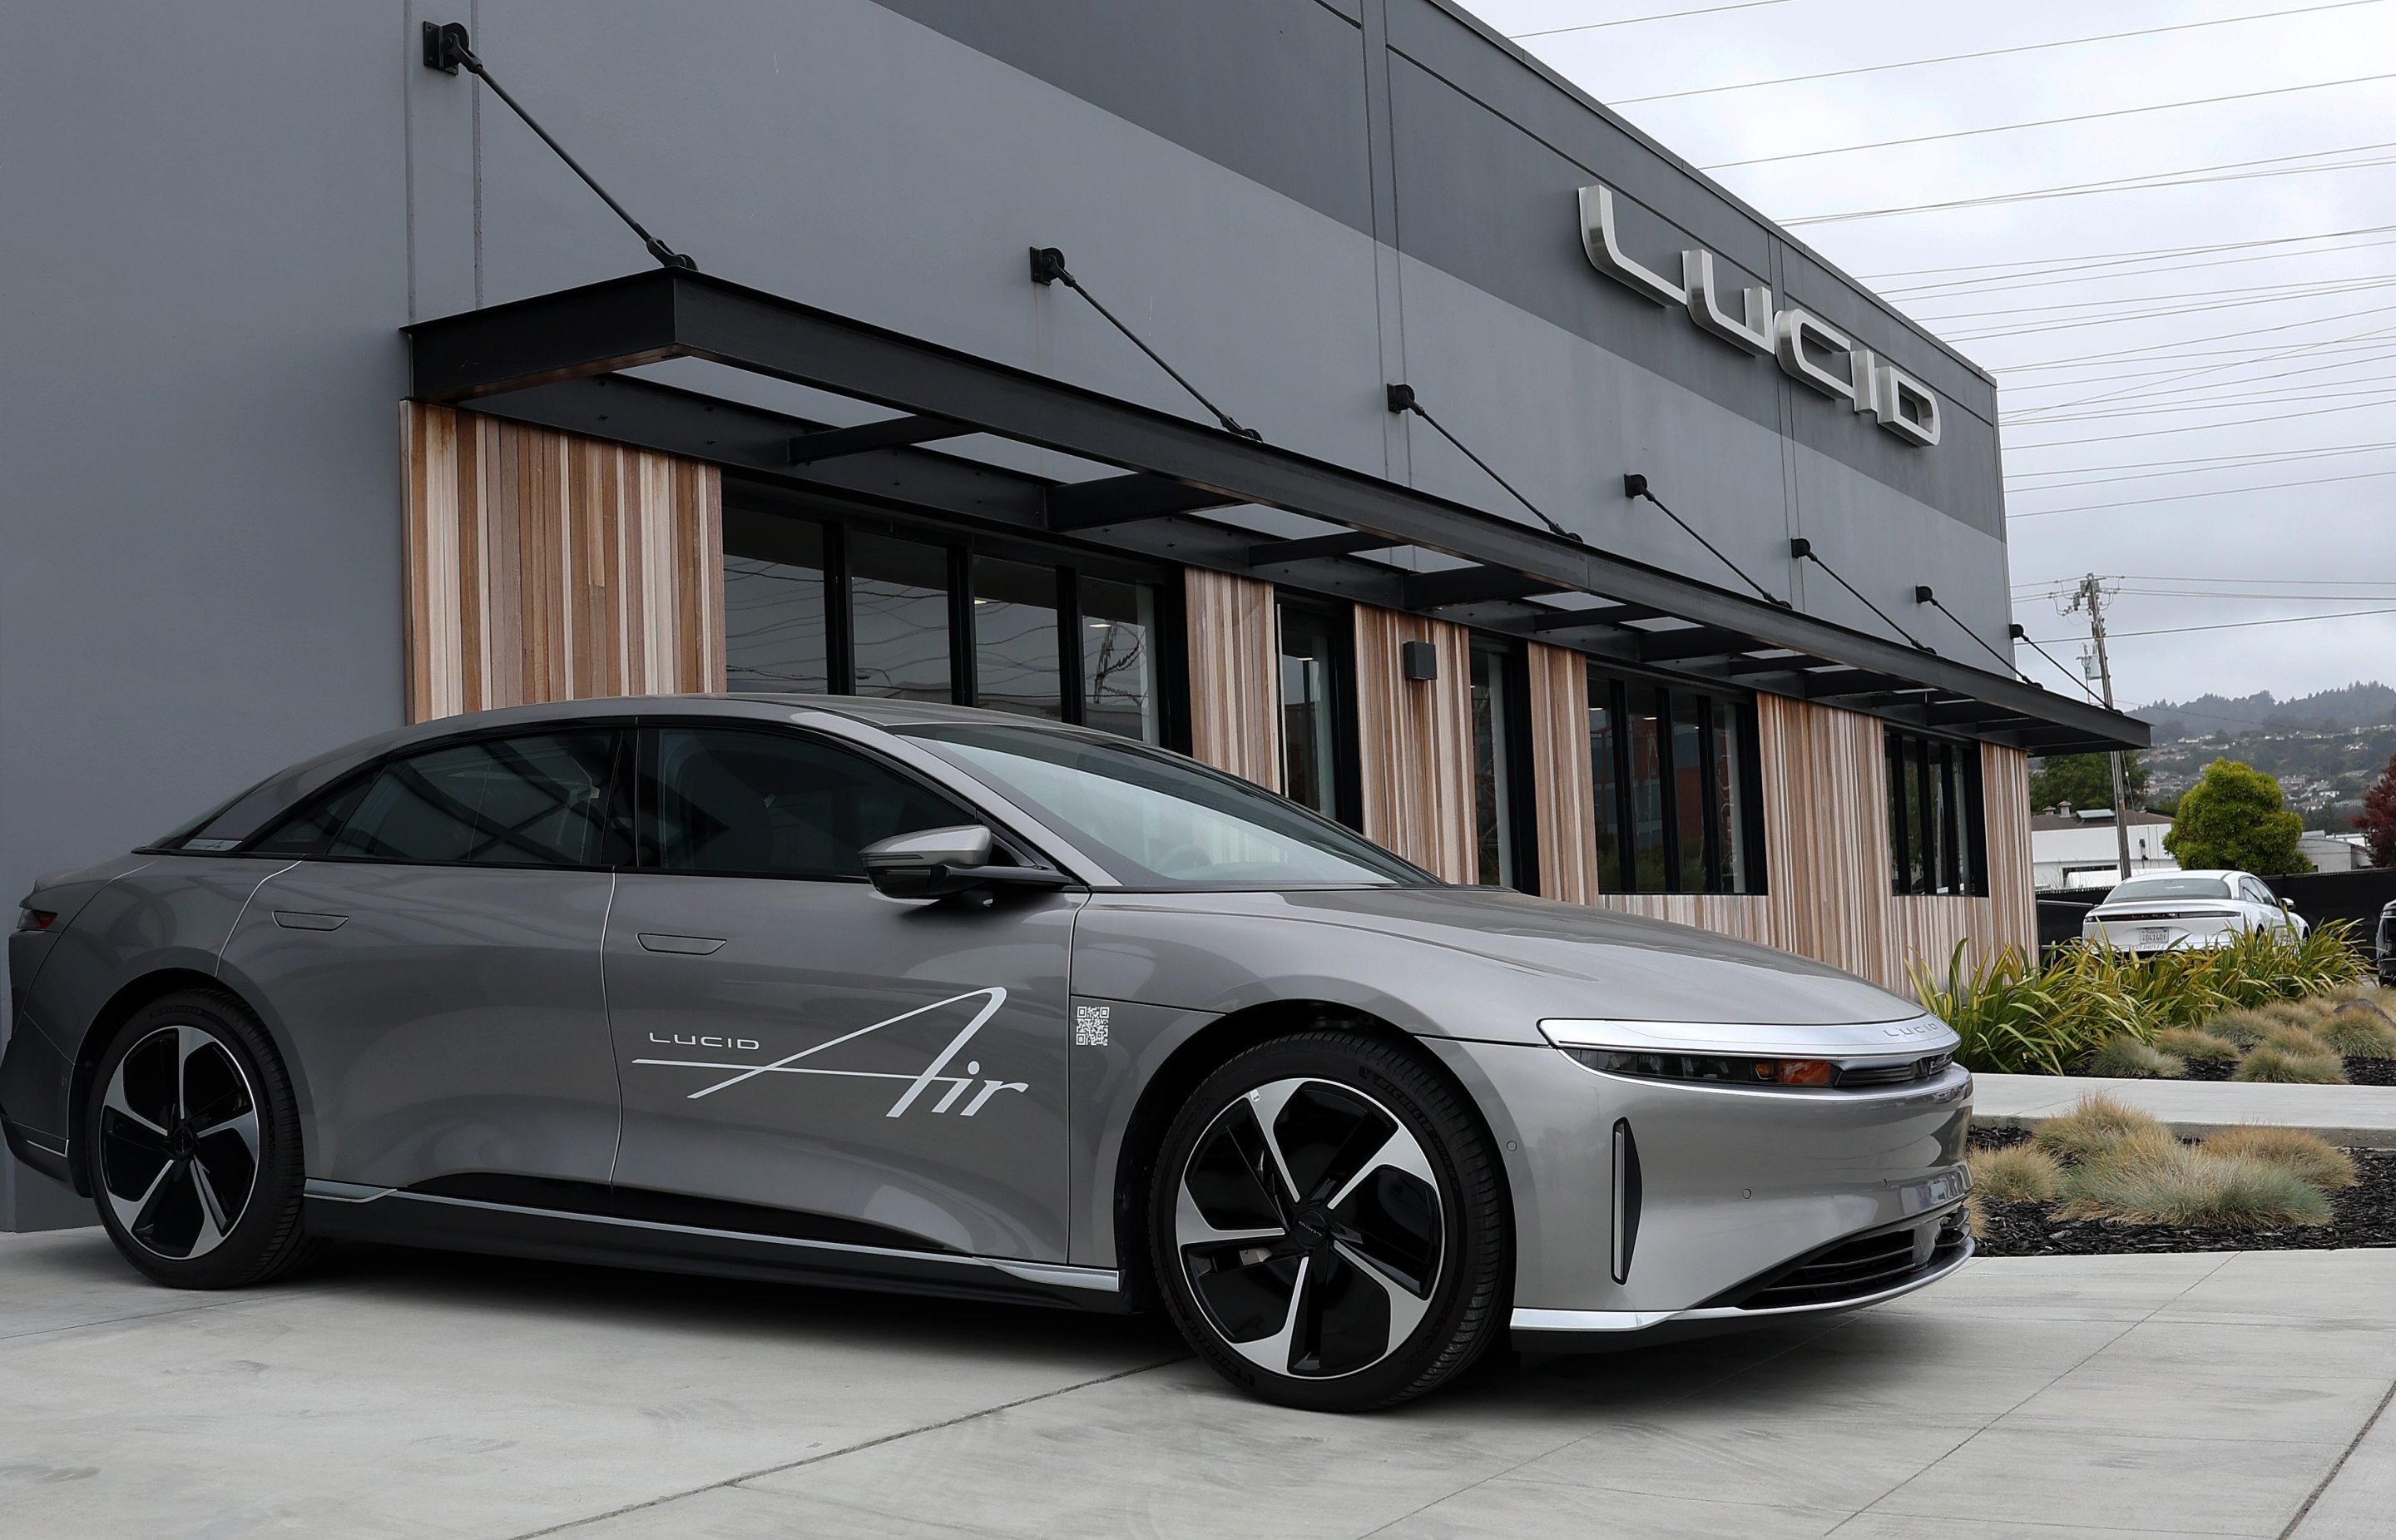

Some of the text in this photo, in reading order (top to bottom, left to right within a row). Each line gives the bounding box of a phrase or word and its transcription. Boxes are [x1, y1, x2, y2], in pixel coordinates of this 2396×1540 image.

[1578, 184, 1941, 448] LUCID
[631, 986, 1029, 1117] Air
[649, 1032, 760, 1050] LUCID
[1883, 1023, 1939, 1037] LUCID
